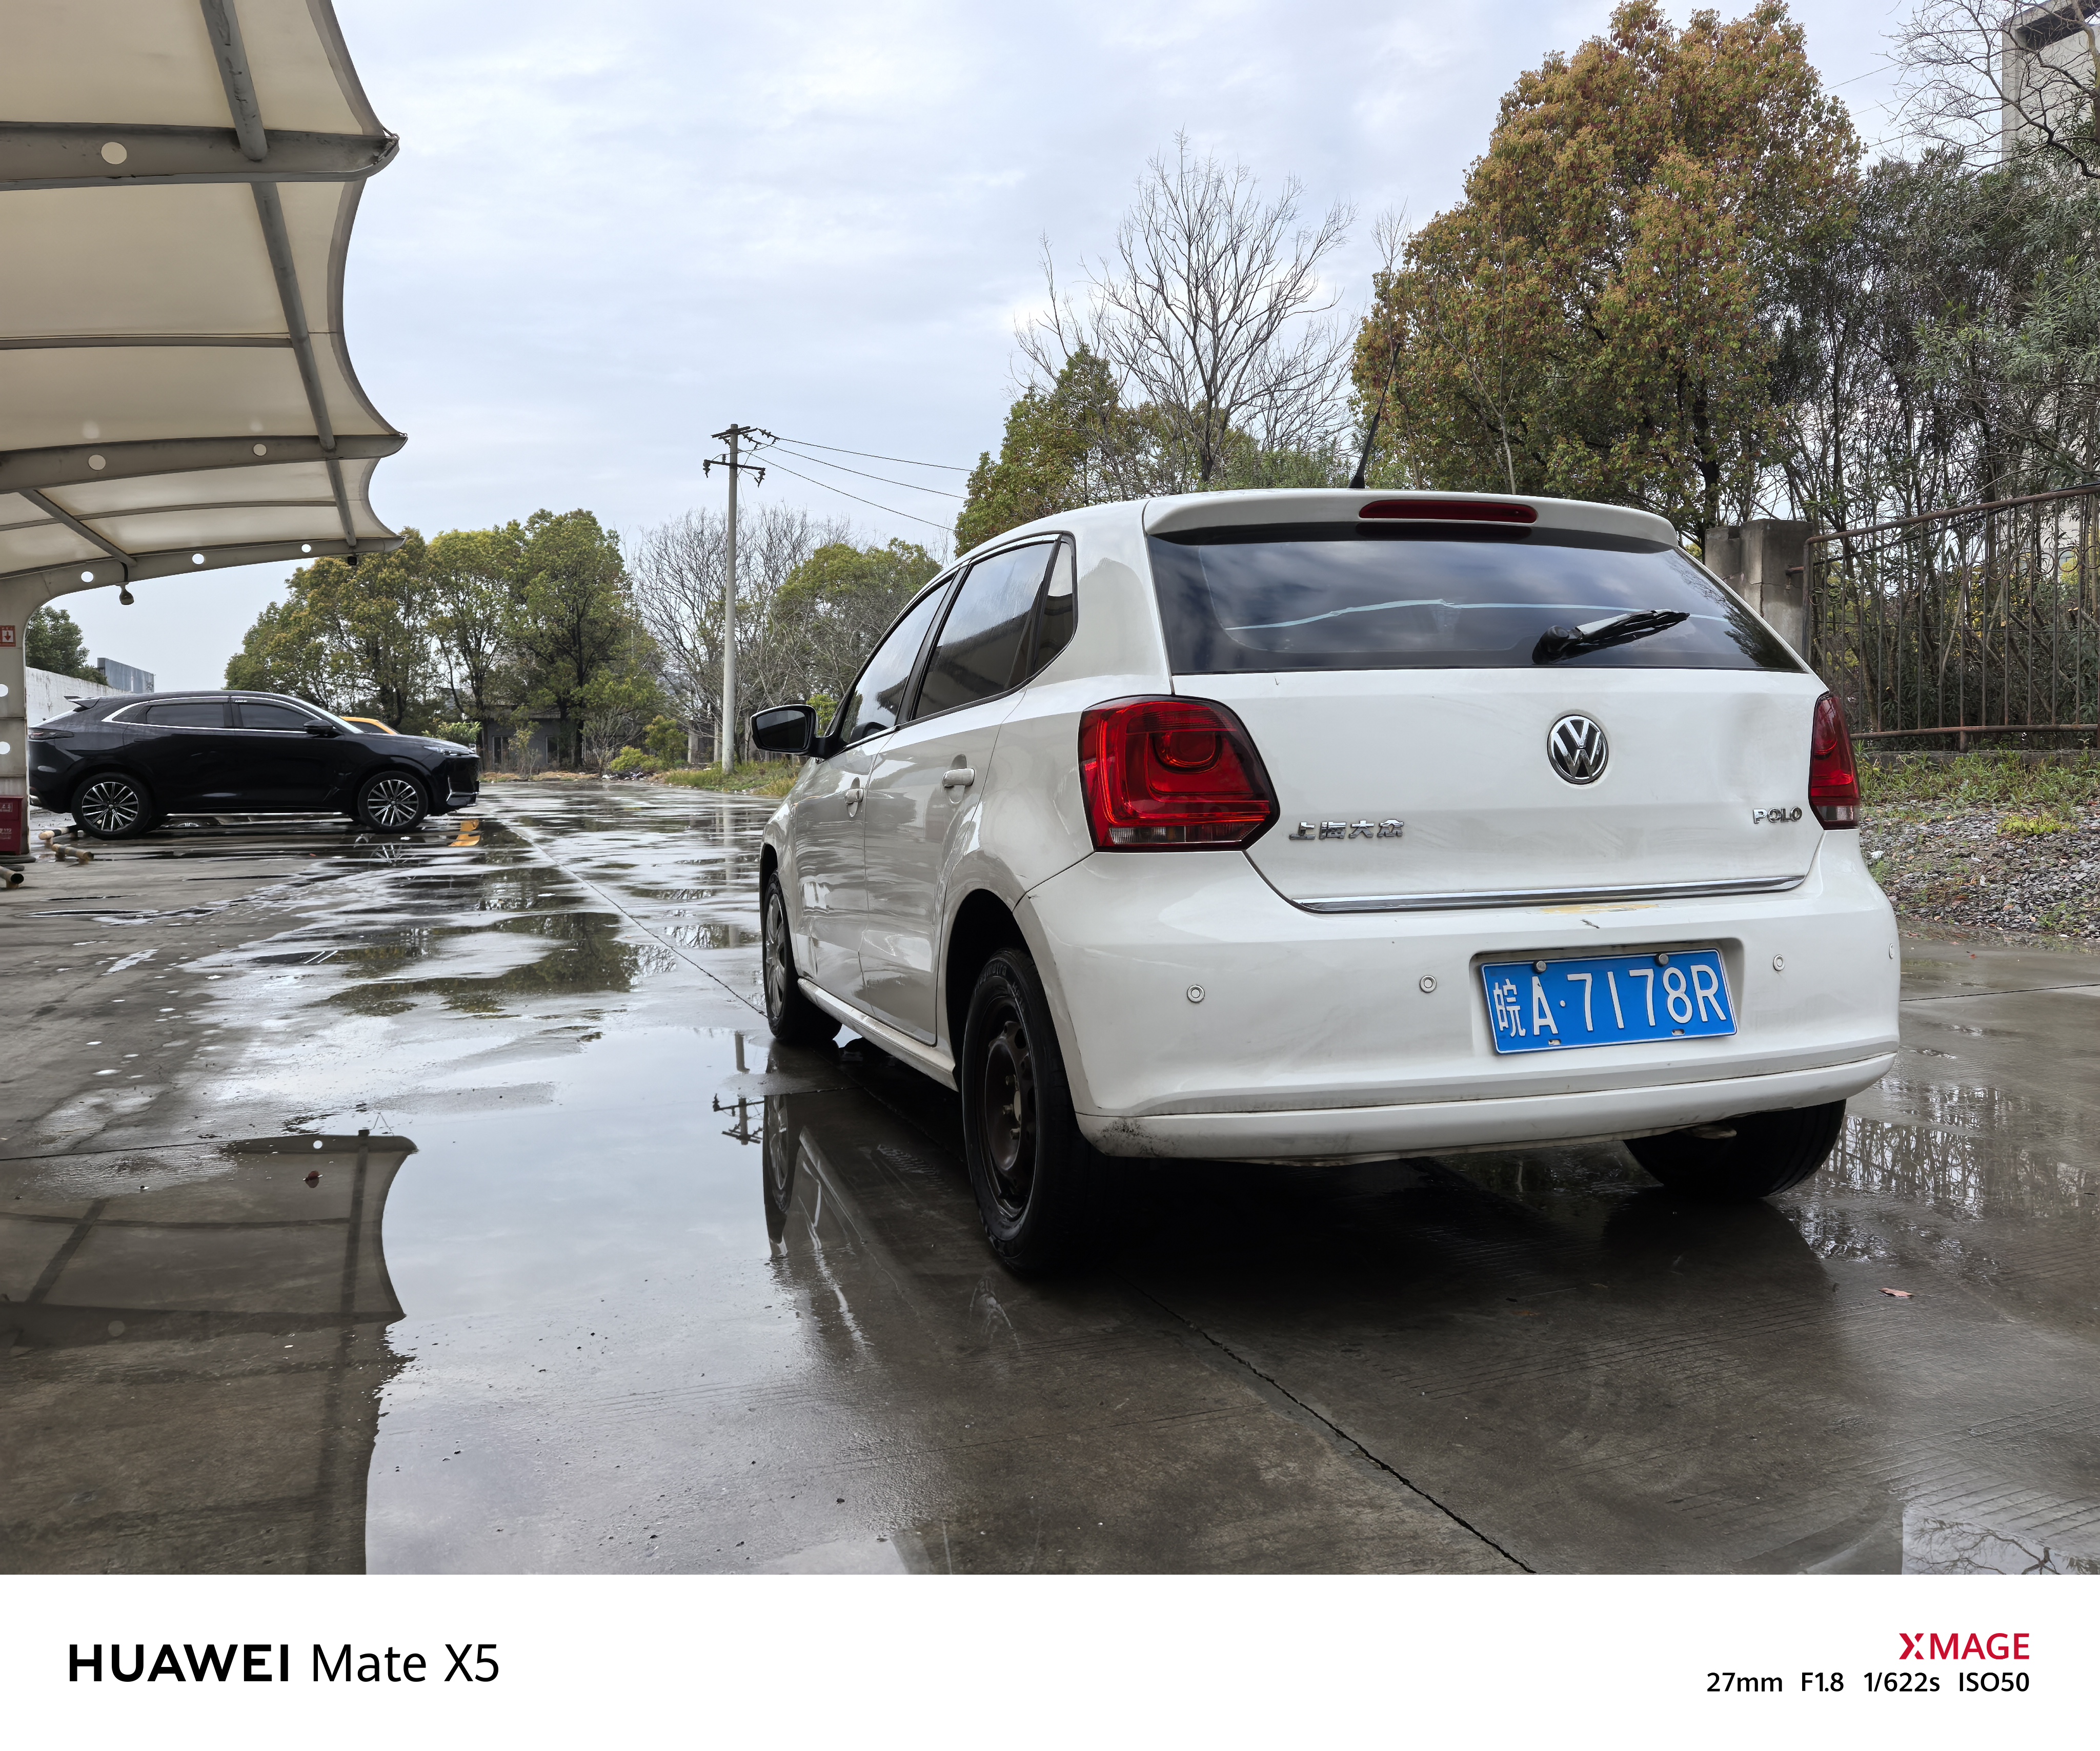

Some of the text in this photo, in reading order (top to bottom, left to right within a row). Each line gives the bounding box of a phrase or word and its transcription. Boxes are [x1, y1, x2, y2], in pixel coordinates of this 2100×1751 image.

[1752, 806, 1803, 824] POLO
[1288, 819, 1404, 840] 上海大众
